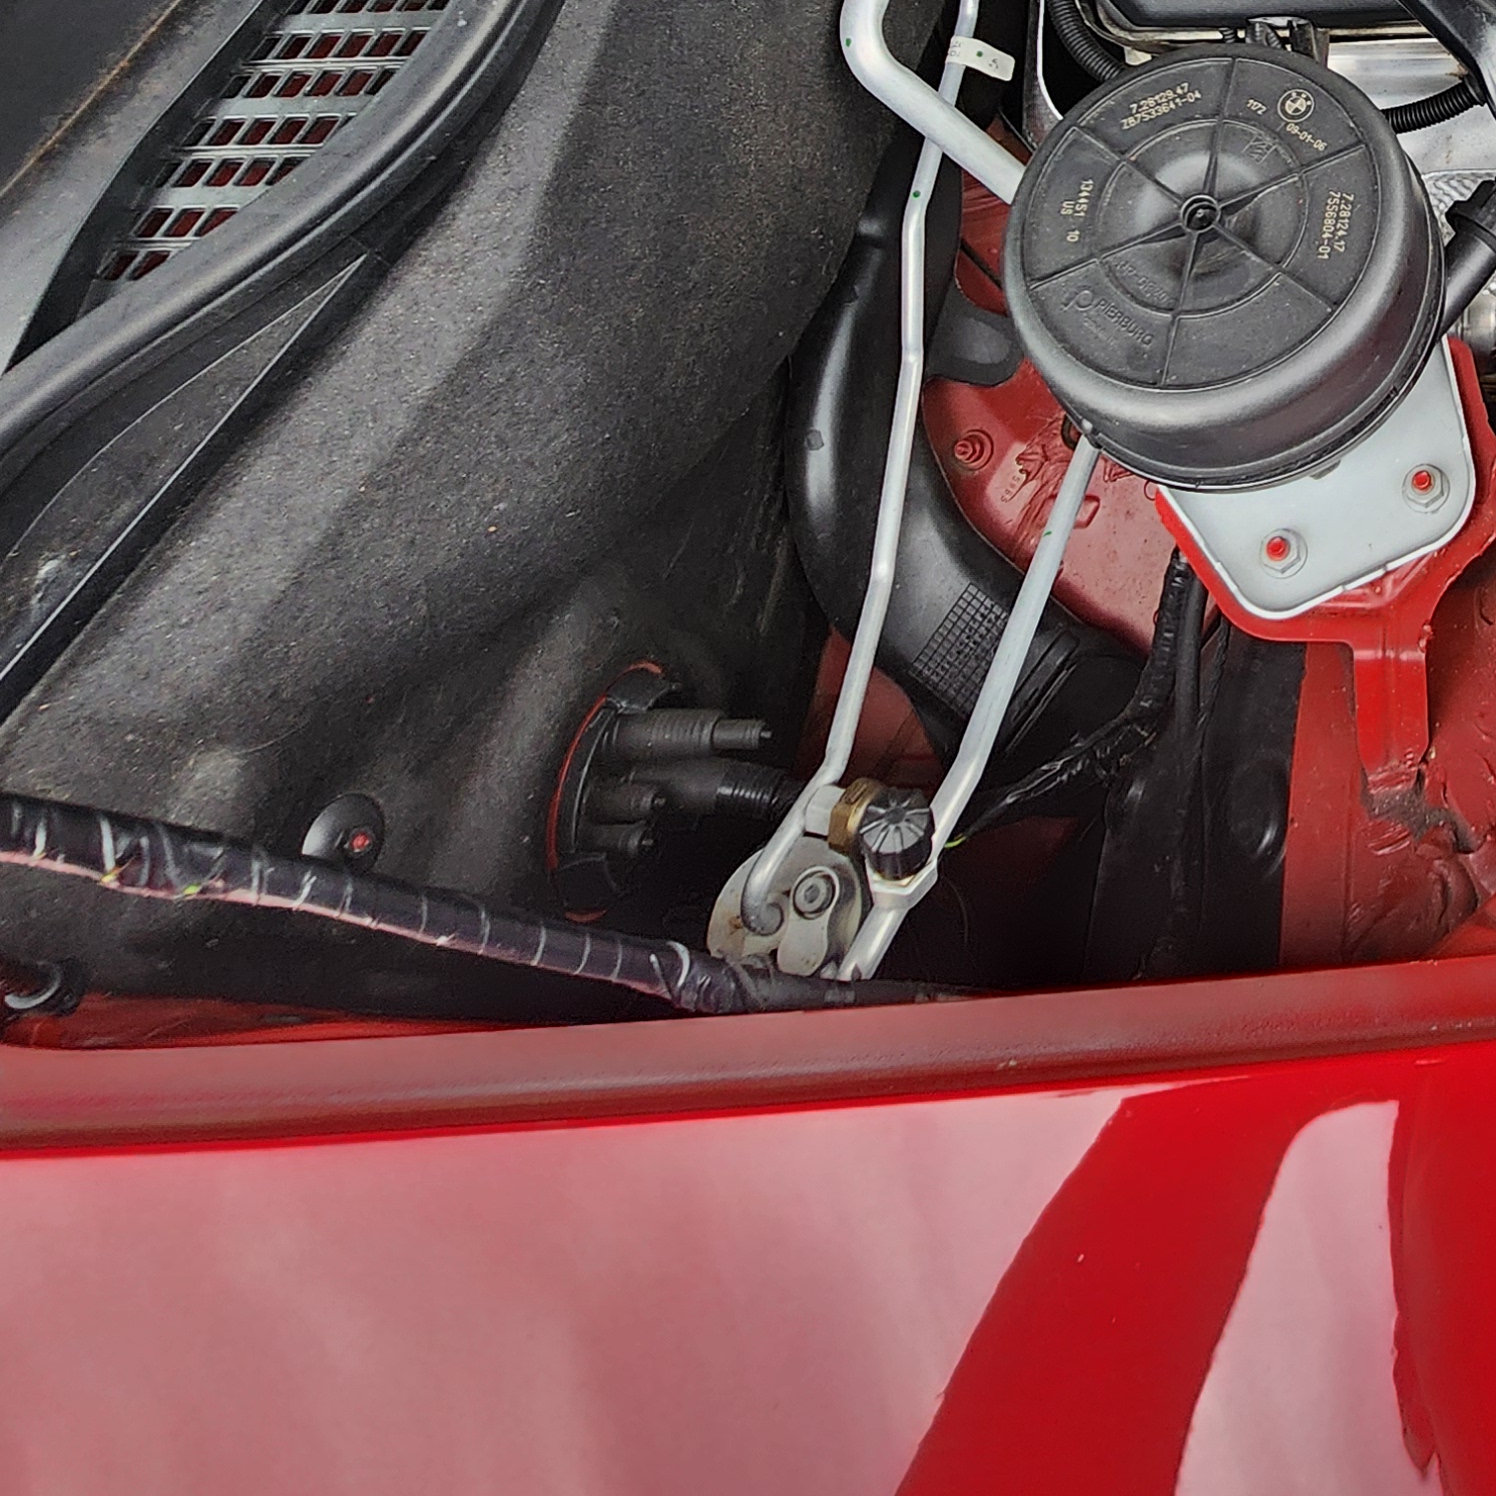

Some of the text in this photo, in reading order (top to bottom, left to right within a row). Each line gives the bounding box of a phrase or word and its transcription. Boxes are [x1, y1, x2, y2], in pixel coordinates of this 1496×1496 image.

[1285, 122, 1328, 152] 09-01-06
[1060, 200, 1076, 216] US
[1316, 190, 1342, 260] 7556804-01
[1333, 192, 1355, 253] 7.28124.17
[1065, 230, 1080, 243] 10
[1095, 297, 1154, 348] PIERBURG
